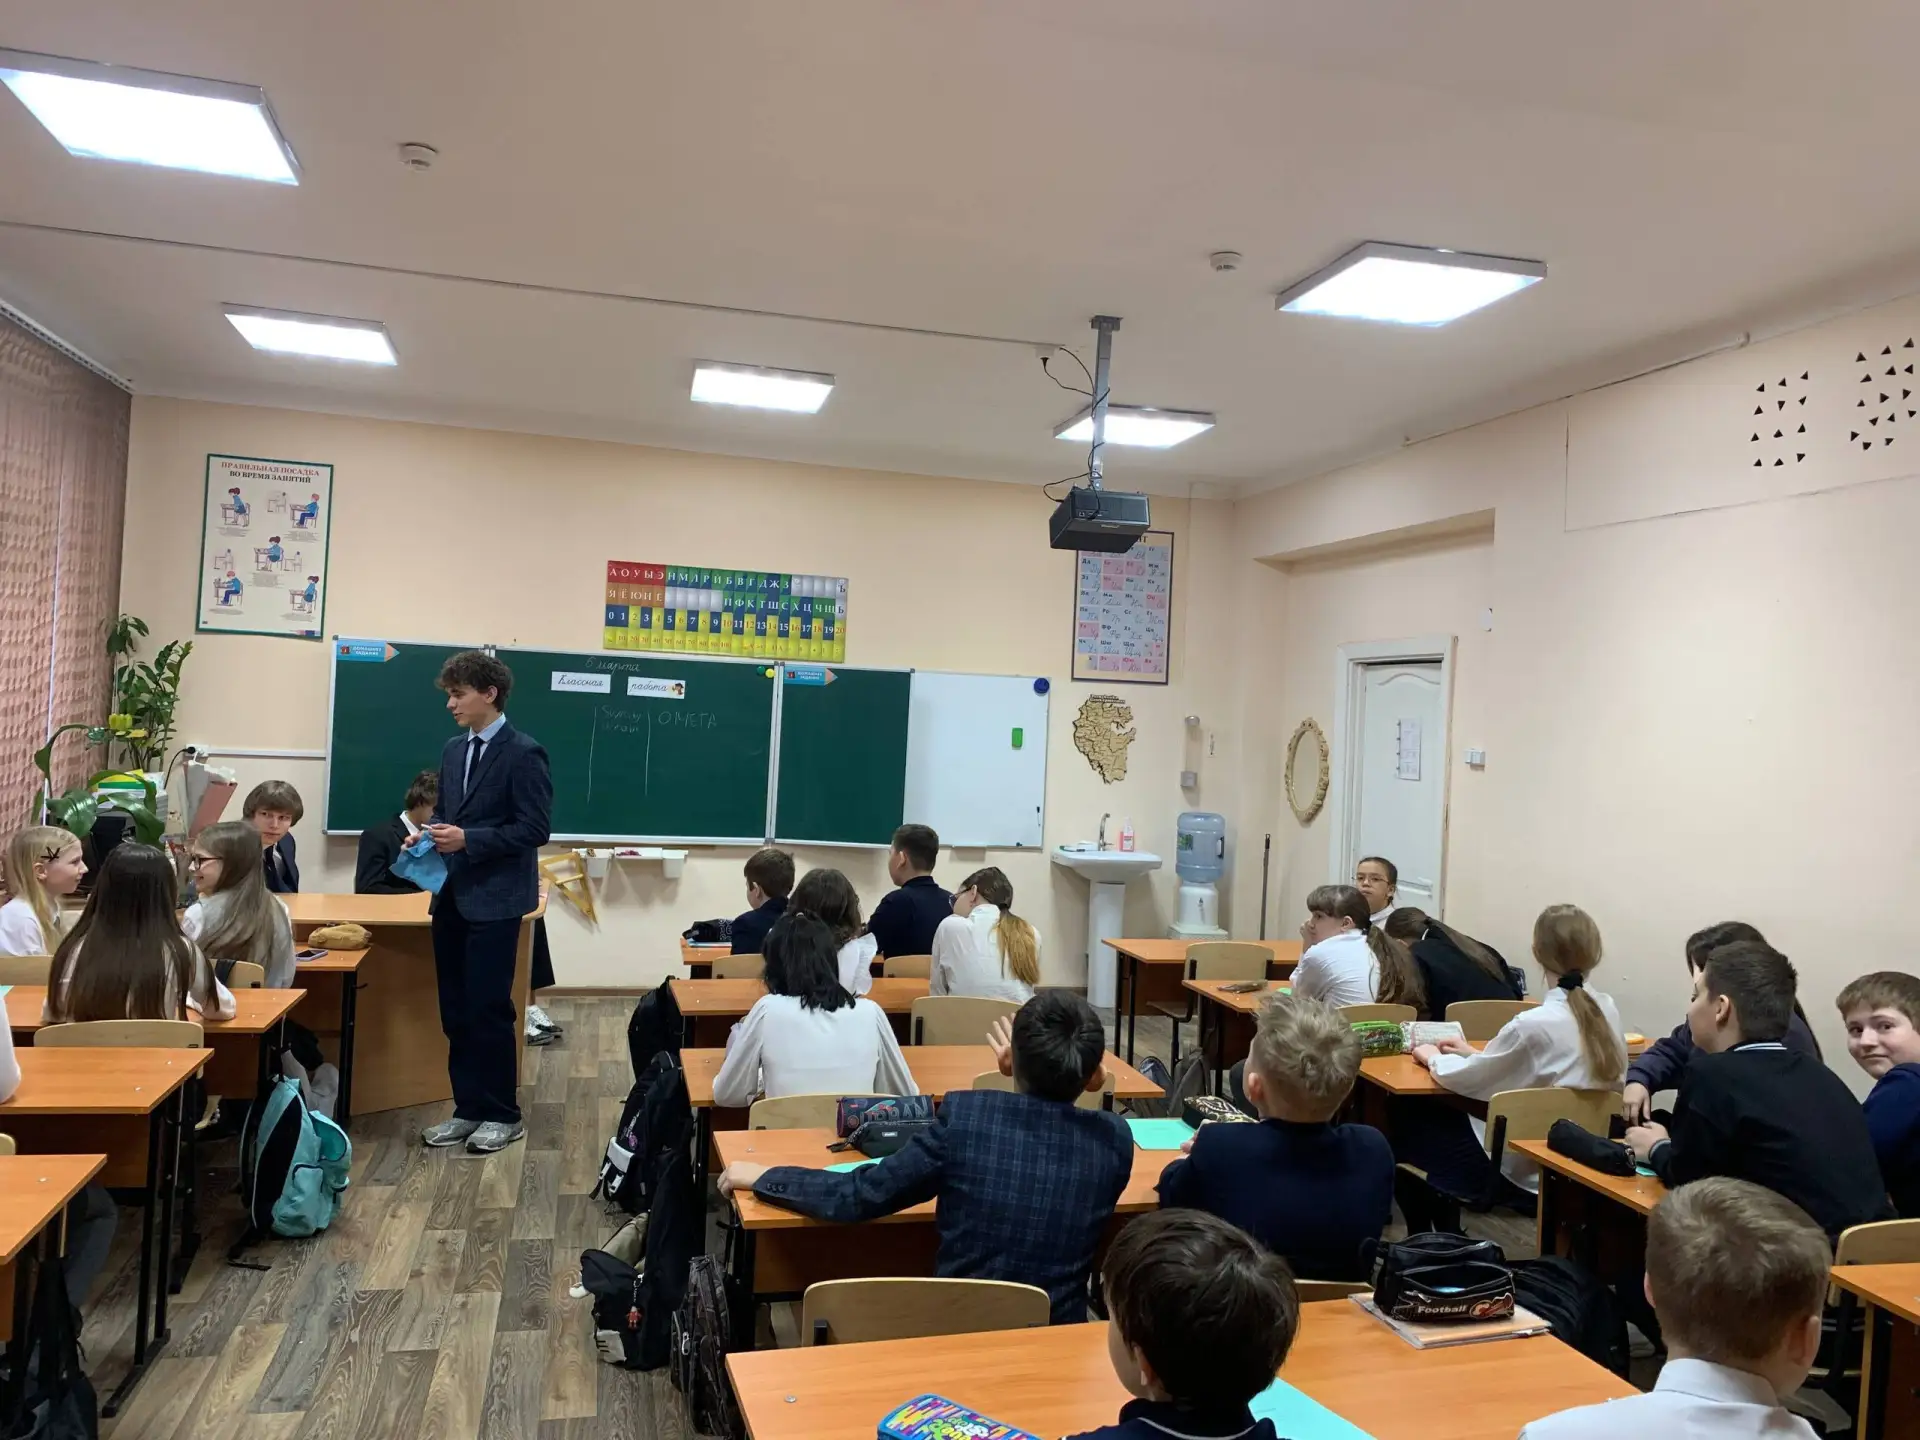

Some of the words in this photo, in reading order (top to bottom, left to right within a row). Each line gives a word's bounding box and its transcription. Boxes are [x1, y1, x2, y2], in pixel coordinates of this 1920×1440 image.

[221, 462, 279, 472] ПРАВИЛЬНАЯ
[281, 467, 320, 476] ПОСАДКА
[242, 472, 270, 480] ВРЕМЯ
[271, 475, 311, 483] ЗАНЯТИЙ
[759, 580, 767, 588] Д
[770, 580, 780, 588] Ж
[622, 589, 627, 598] Ё
[804, 604, 811, 612] Ц
[558, 674, 604, 686] Классная
[629, 680, 668, 693] работа
[658, 710, 717, 729] ОМЕГА
[1418, 1304, 1468, 1314] Football
